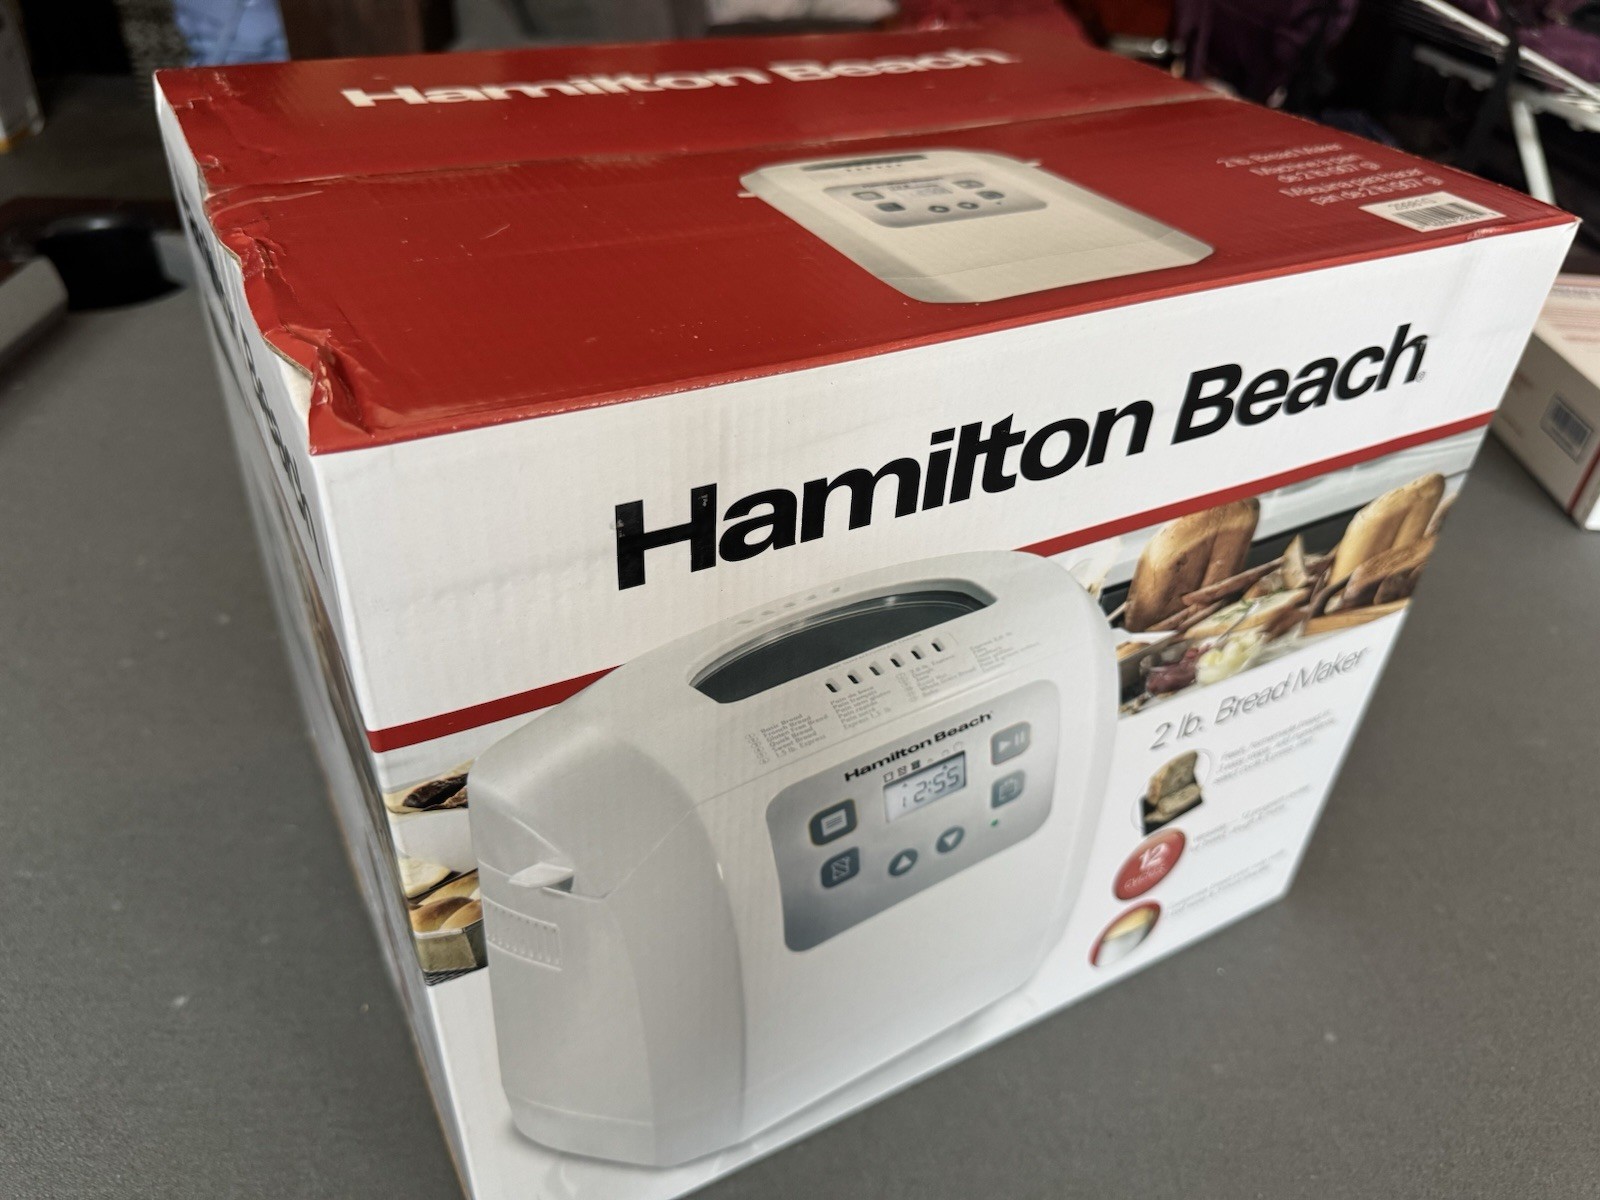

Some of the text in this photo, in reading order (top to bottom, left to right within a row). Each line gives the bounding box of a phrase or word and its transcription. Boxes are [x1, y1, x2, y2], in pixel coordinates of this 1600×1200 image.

[340, 48, 1014, 107] Hamilton Beach
[614, 323, 1427, 591] Hamilton Beach
[1150, 721, 1171, 750] 2
[1176, 713, 1203, 739] lb.
[1215, 671, 1292, 724] Bread
[1292, 647, 1368, 693] Maker
[780, 713, 803, 725] Bread
[788, 715, 811, 727] Bread
[790, 726, 813, 738] Bread
[794, 730, 817, 743] Bread
[844, 712, 993, 782] Hamilton Beach
[1139, 843, 1167, 871] 12
